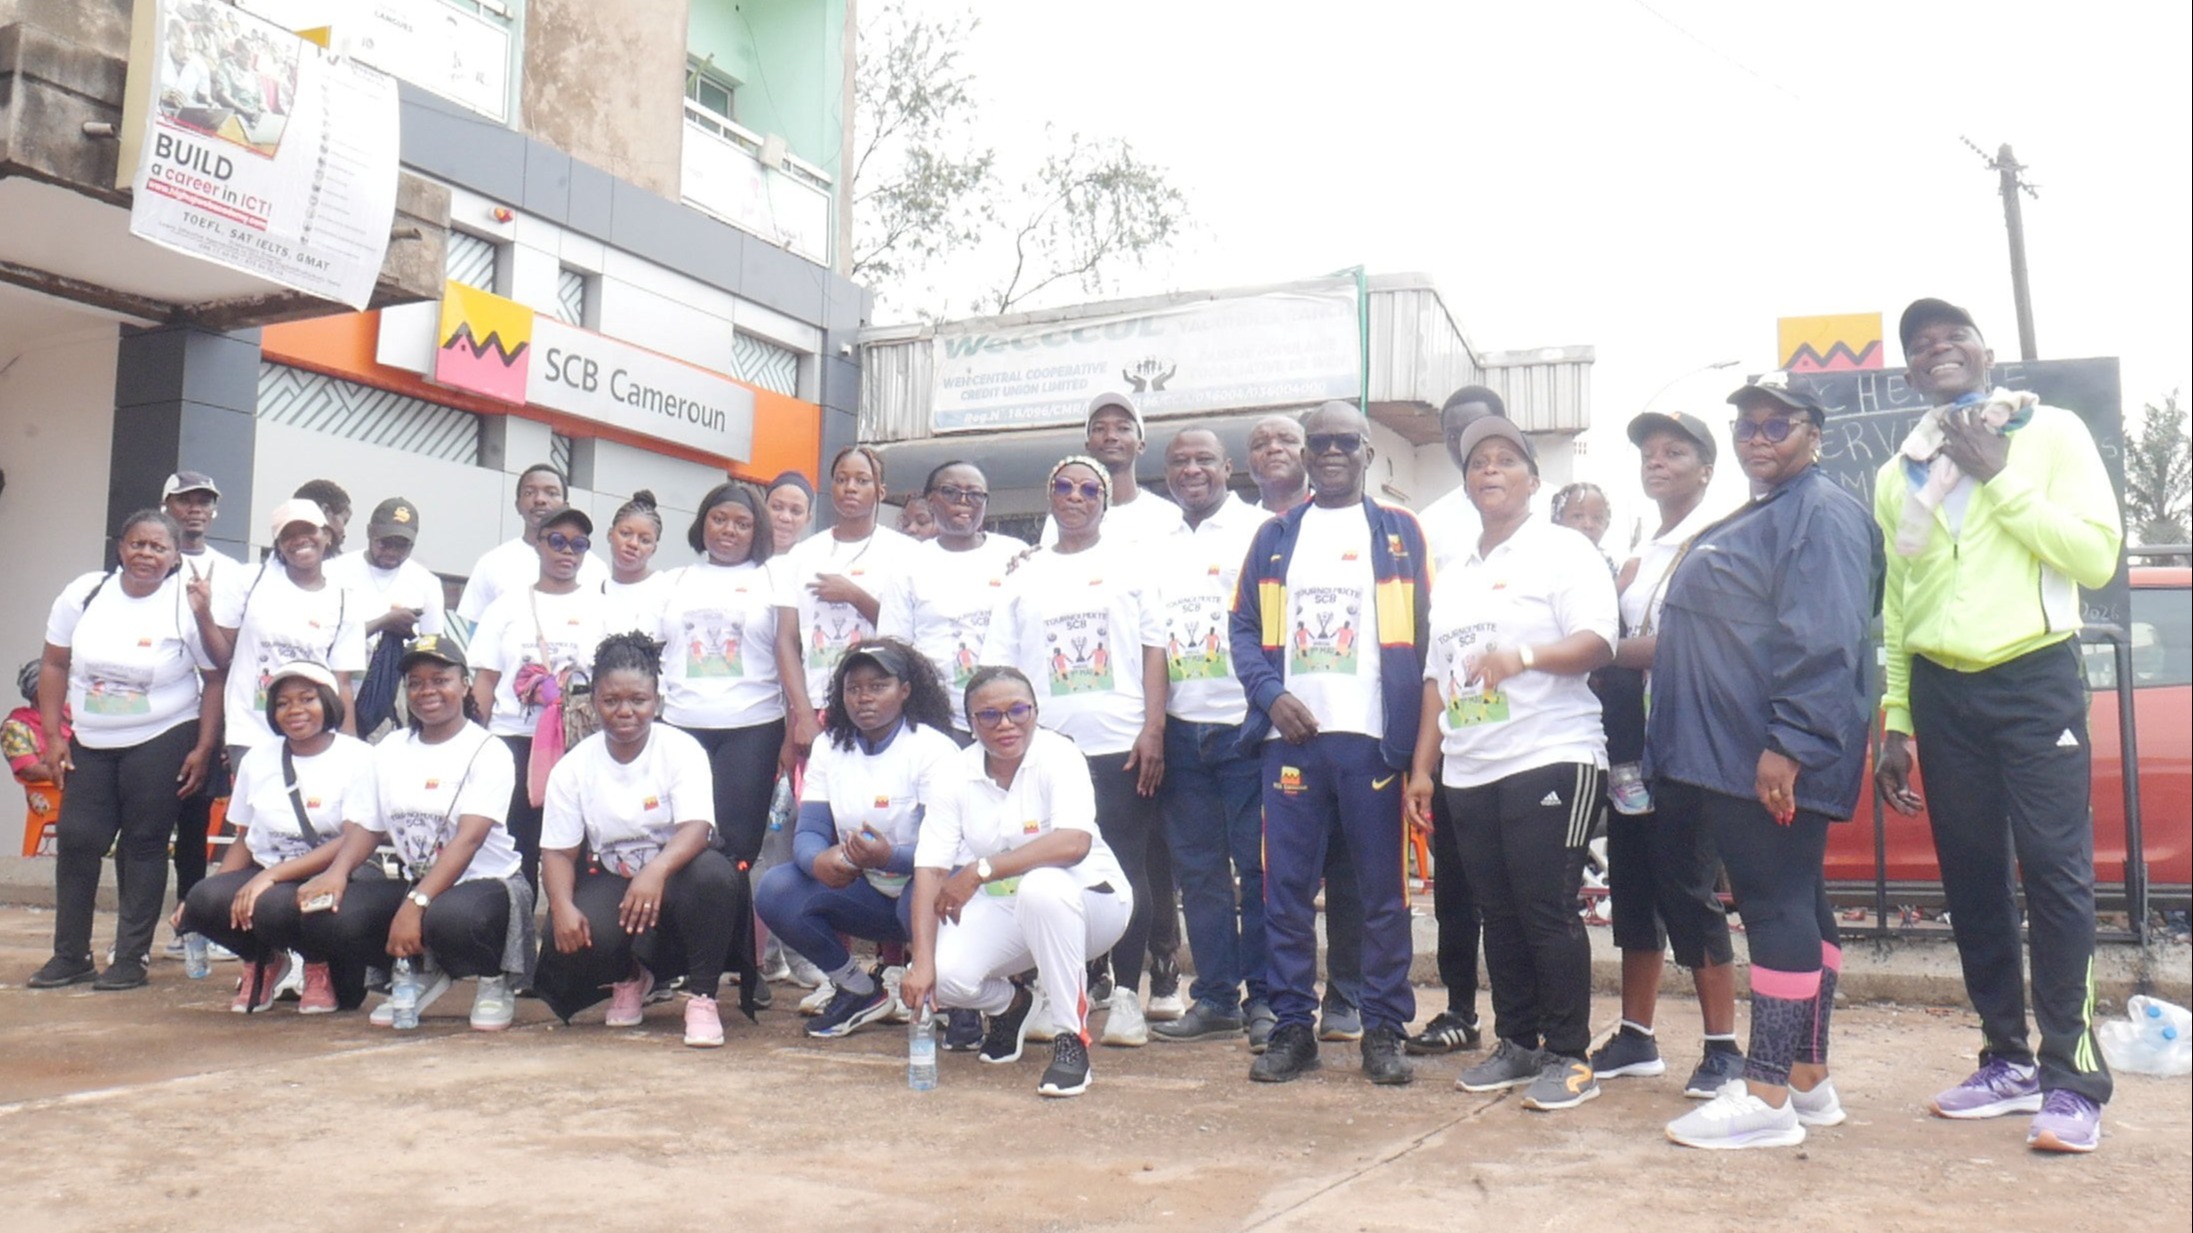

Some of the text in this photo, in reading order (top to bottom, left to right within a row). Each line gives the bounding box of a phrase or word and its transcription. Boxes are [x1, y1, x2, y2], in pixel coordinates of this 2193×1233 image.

[155, 132, 234, 181] BUILD
[151, 162, 163, 176] a
[165, 167, 220, 198] career
[222, 184, 238, 205] in
[240, 193, 273, 217] ICT!
[230, 228, 254, 244] SAT
[296, 251, 331, 272] GMAT
[974, 370, 1022, 386] CENTRAL
[1026, 361, 1108, 381] COOPERATIVE
[545, 347, 727, 433] SCB Cameroun
[960, 378, 1089, 403] CREDIT UNION LIMITED
[1314, 594, 1337, 605] SCB
[1066, 619, 1088, 631] SCB
[1437, 627, 1472, 646] TOURNOI
[1458, 632, 1477, 648] SCB
